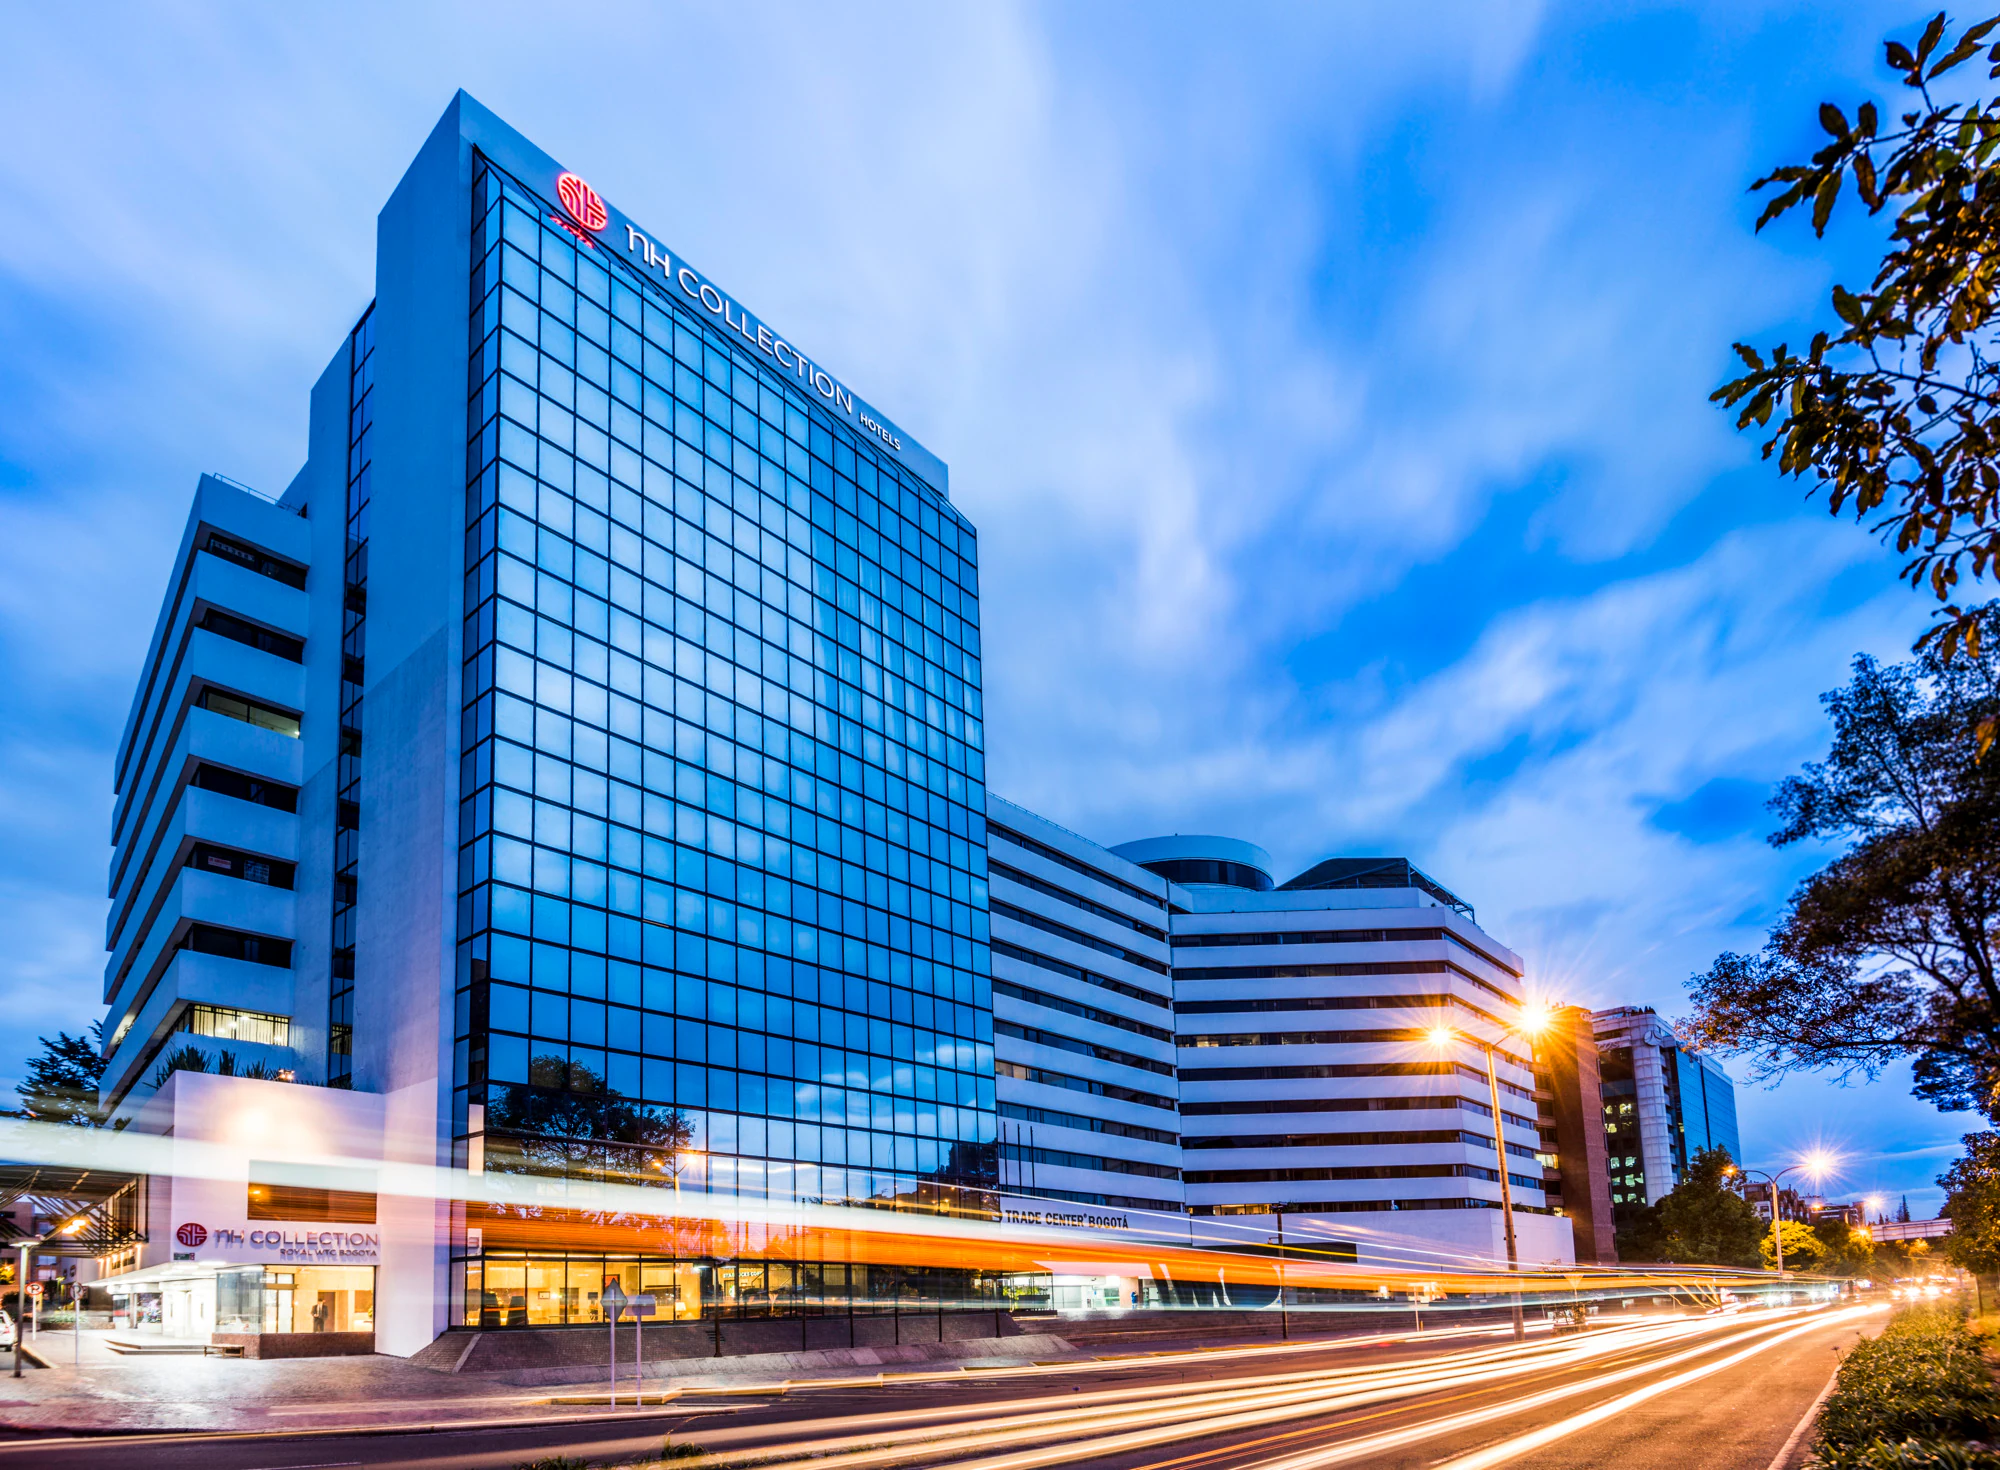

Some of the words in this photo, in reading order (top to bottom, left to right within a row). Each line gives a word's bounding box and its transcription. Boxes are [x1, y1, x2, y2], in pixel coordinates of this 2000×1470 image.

[678, 268, 852, 414] COLLECTION
[860, 411, 901, 450] HOTELS
[1005, 1209, 1042, 1225] TRADE
[1088, 1214, 1129, 1229] BOGOTÁ
[250, 1229, 378, 1247] COLLECTION
[280, 1248, 313, 1257] ROYAL
[315, 1249, 337, 1257] WTC
